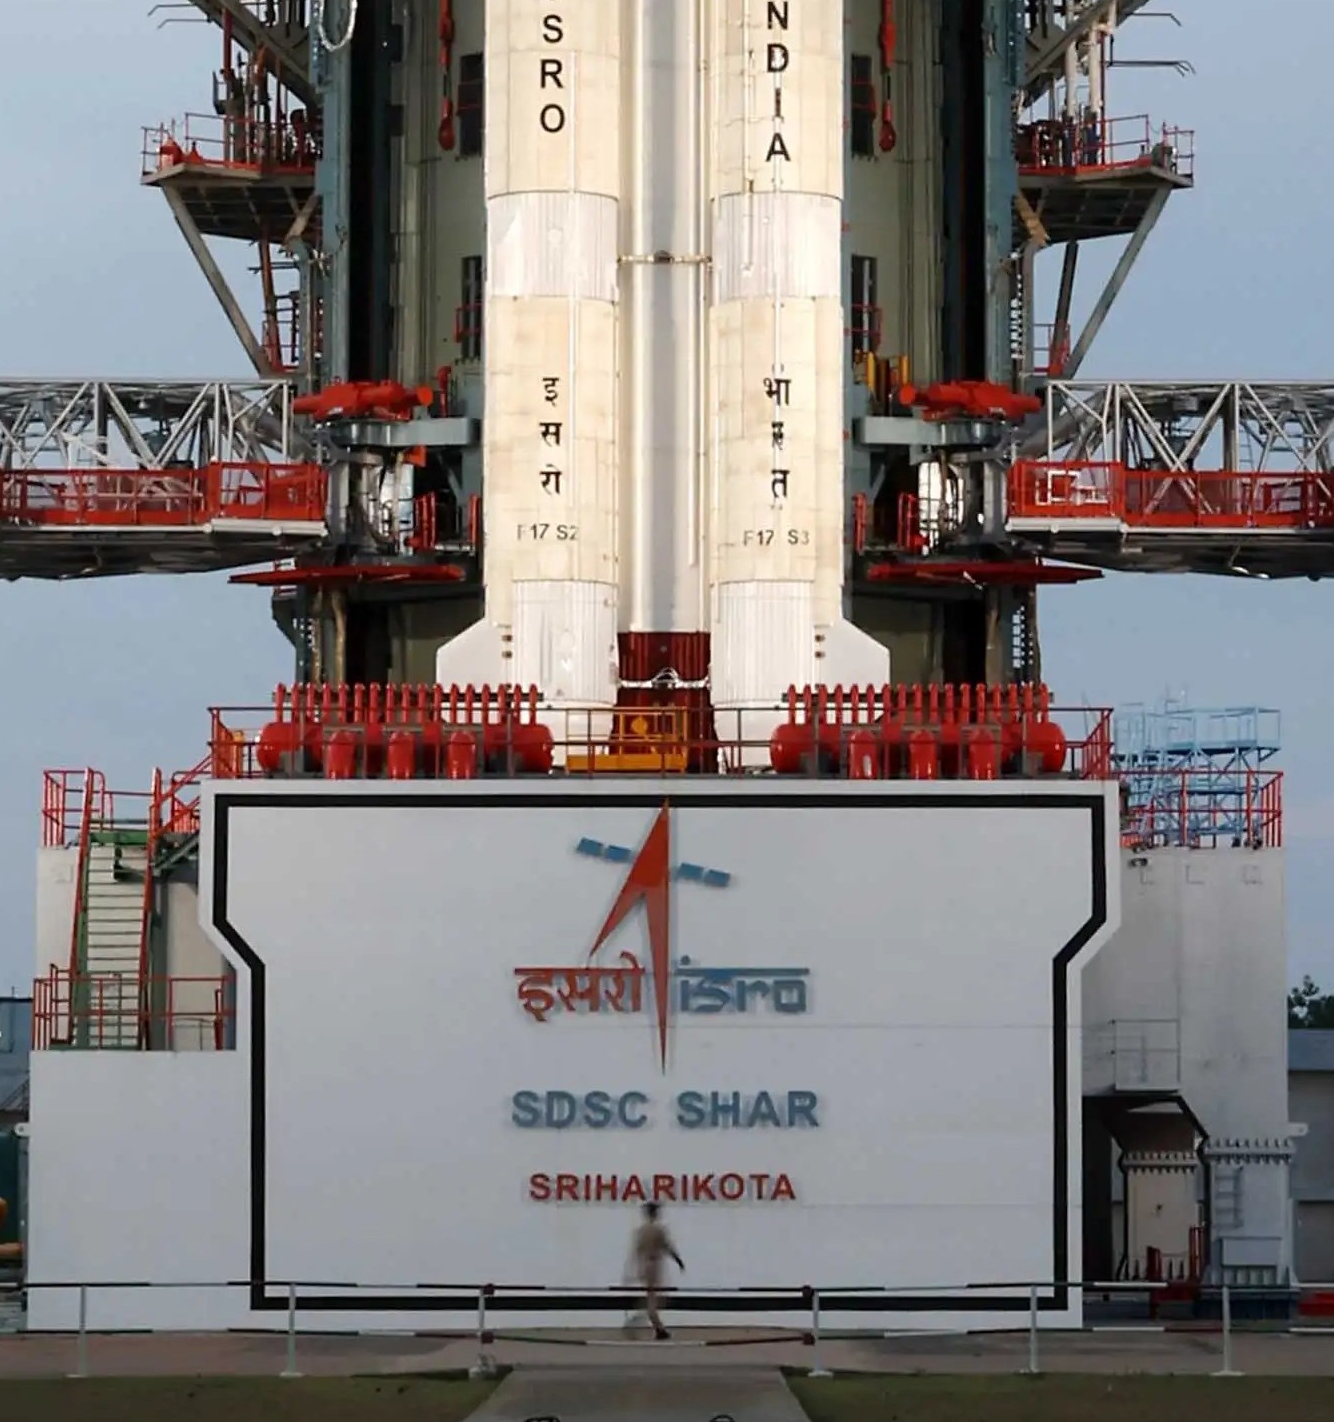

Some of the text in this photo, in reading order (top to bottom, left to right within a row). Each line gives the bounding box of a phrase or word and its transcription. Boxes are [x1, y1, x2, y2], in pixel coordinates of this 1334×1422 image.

[539, 377, 563, 495] इसरो
[743, 529, 775, 546] F17
[514, 950, 645, 1022] इसरो
[512, 1090, 820, 1129] SDSC SHAR
[529, 1172, 797, 1202] SRIHARIKOTA
